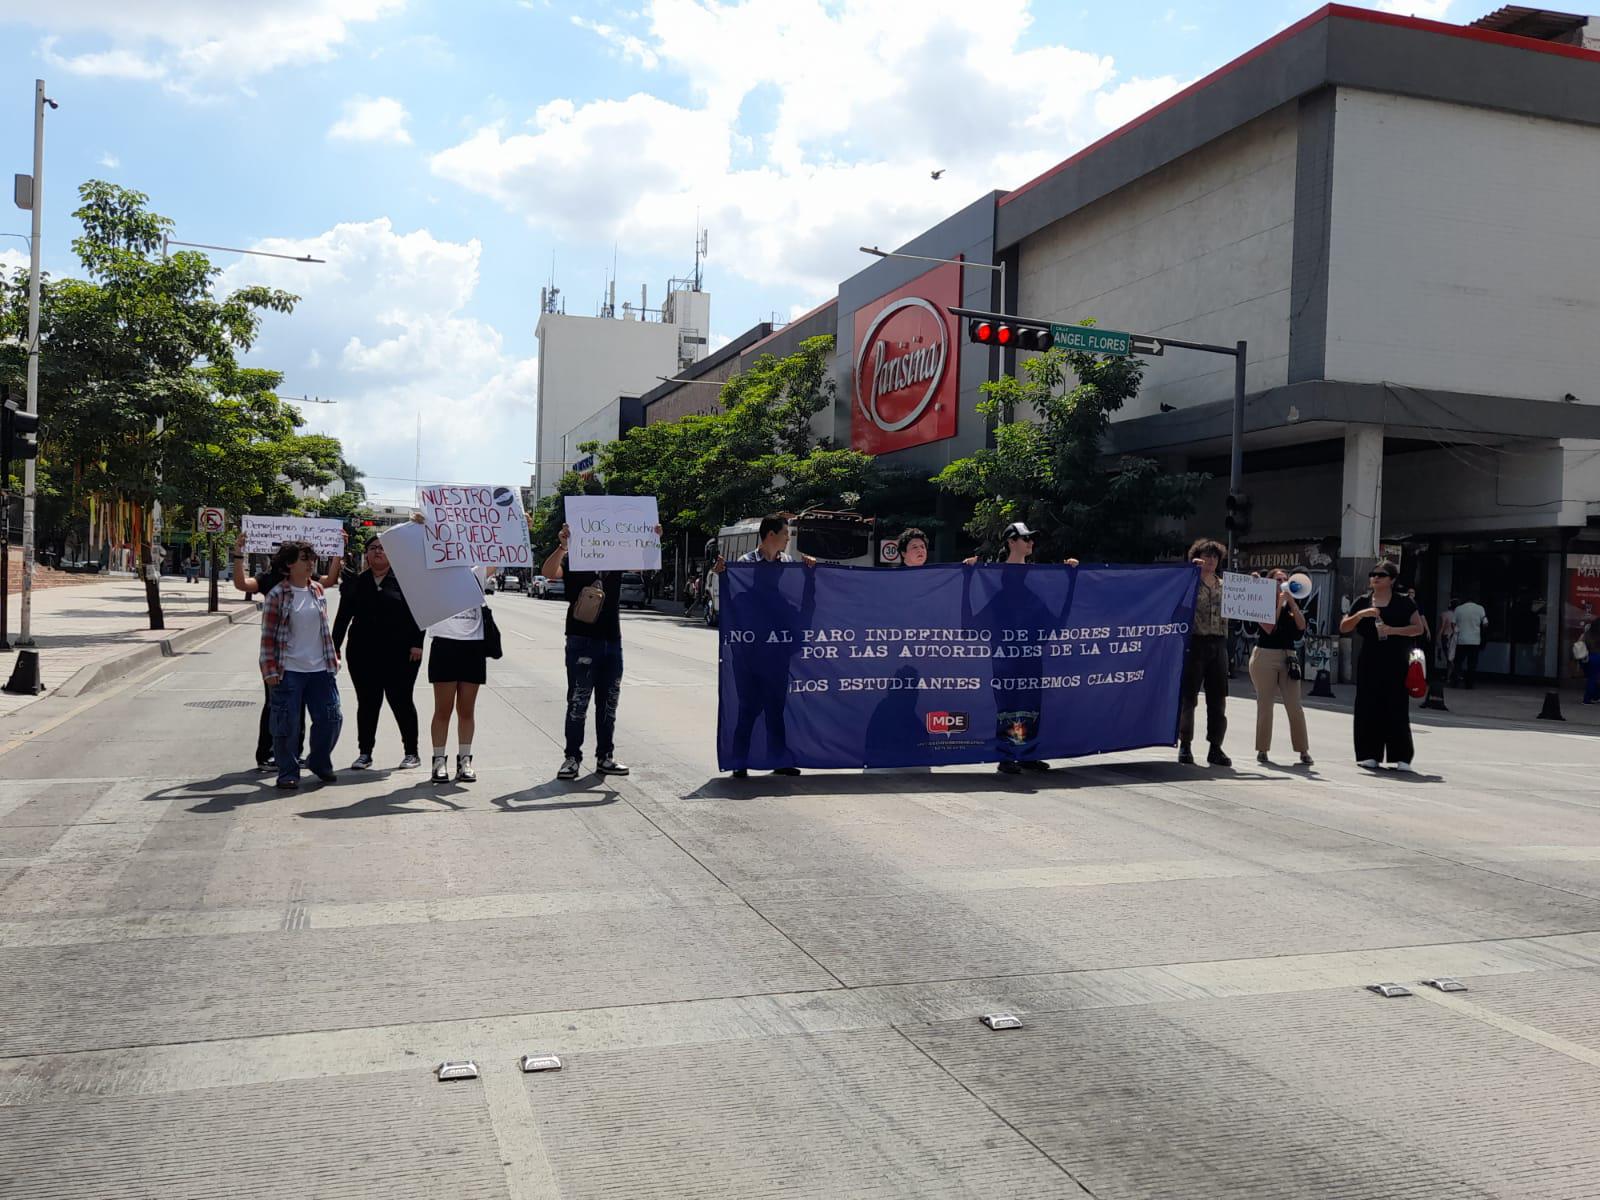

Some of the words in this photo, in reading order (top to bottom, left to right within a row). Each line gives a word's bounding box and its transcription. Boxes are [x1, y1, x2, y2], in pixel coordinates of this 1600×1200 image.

[1054, 331, 1086, 347] ANGEL
[1088, 335, 1126, 352] FLORES
[421, 487, 493, 507] NUESTRO
[434, 507, 500, 524] DERECHO
[507, 506, 518, 522] A
[424, 523, 452, 542] NO
[455, 523, 503, 545] PUEDE
[602, 539, 615, 547] no
[431, 542, 467, 563] SER
[469, 544, 529, 563] NEGADO
[885, 546, 897, 555] 30
[1249, 553, 1301, 567] CATEDRAL
[724, 630, 756, 645] ¡NO
[765, 630, 793, 643] AL
[801, 629, 856, 643] PARO
[865, 629, 992, 642] INDEFINIDO
[1002, 629, 1029, 642] DE
[1037, 627, 1111, 642] LABORES
[1117, 622, 1189, 638] IMPUESTO
[801, 646, 839, 659] POR
[849, 645, 888, 658] LAS
[899, 645, 1042, 658] AUTORIDADES
[1050, 644, 1072, 657] DE
[1079, 643, 1101, 656] LA
[1109, 640, 1142, 654] UAS!
[788, 679, 829, 694] ¡LOS
[839, 677, 981, 691] ESTUDIANTES
[990, 675, 1081, 691] QUEREMOS
[1087, 669, 1145, 686] CLASES!
[932, 715, 965, 726] MDE
